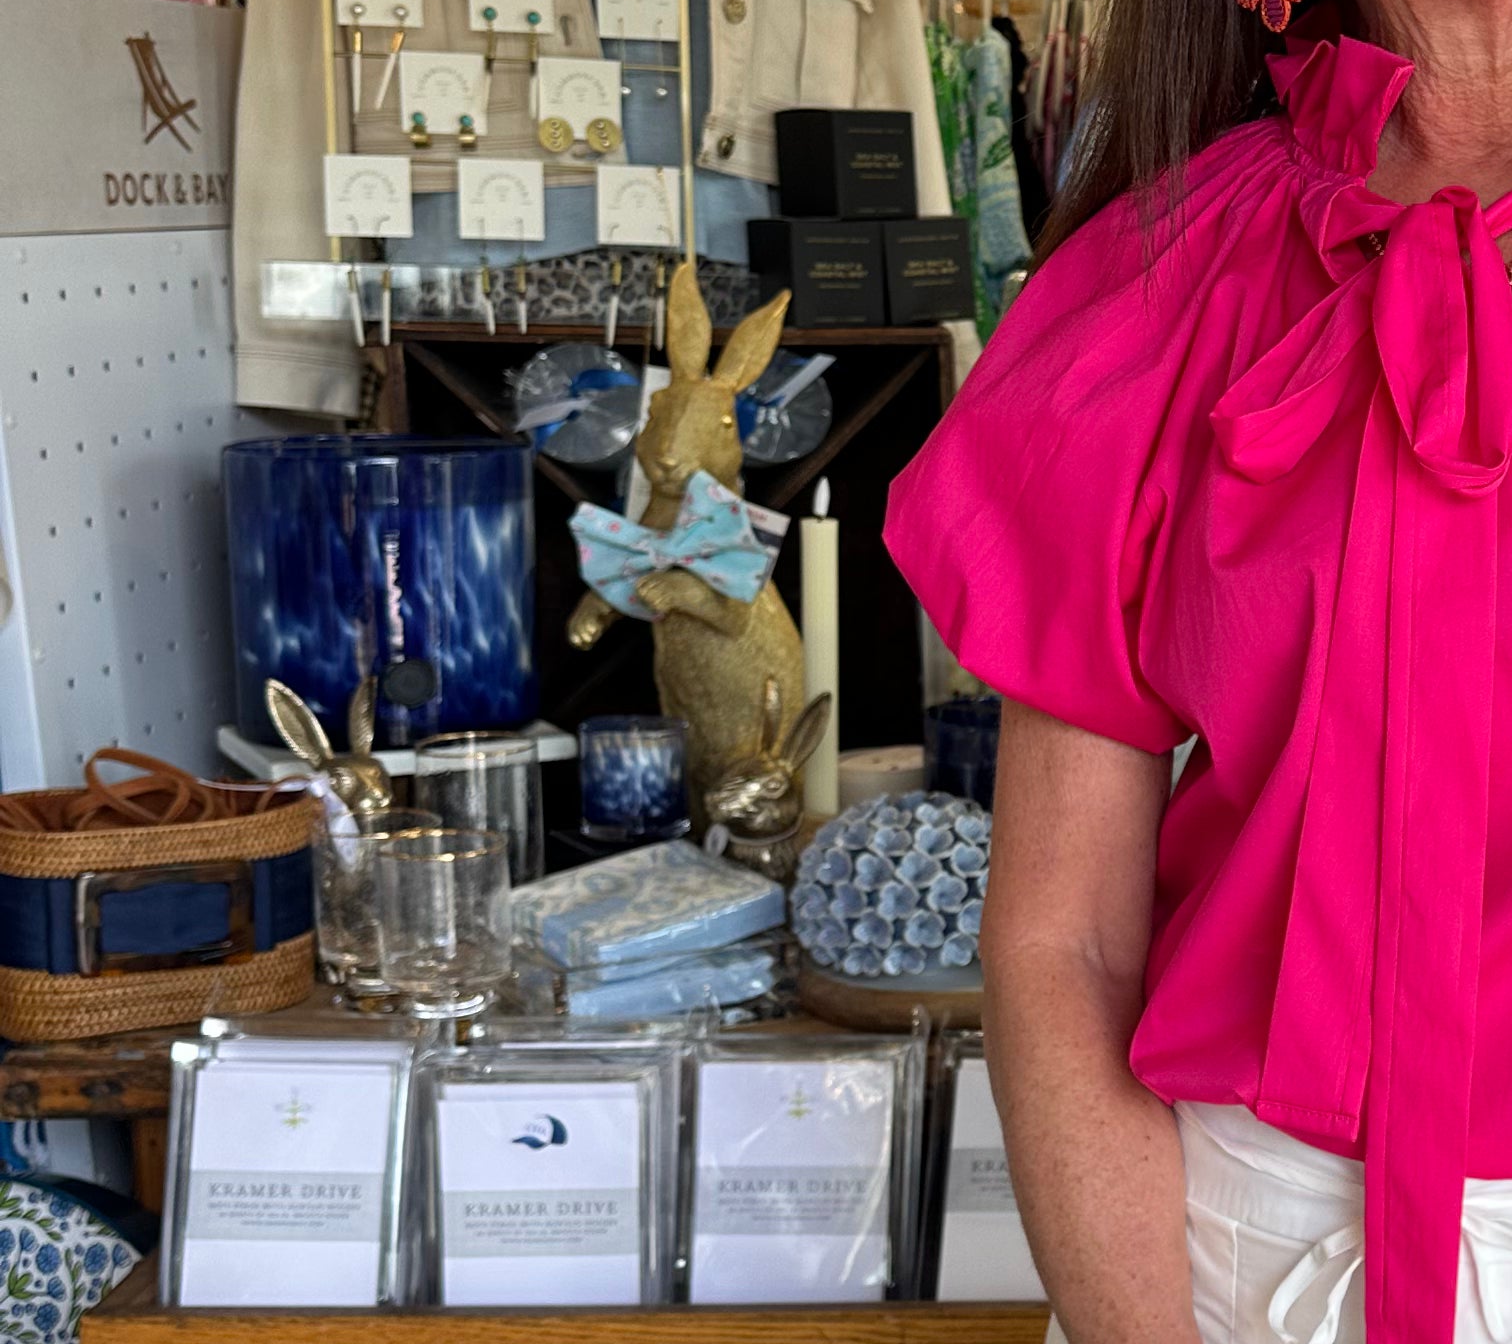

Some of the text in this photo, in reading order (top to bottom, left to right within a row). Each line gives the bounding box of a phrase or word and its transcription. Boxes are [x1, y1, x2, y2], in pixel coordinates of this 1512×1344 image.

[104, 172, 229, 206] DOCK & BAY
[208, 1183, 362, 1199] KRAMER DRIVE
[719, 1180, 799, 1193] KRAMER
[464, 1200, 618, 1217] KRAMER DRIVE
